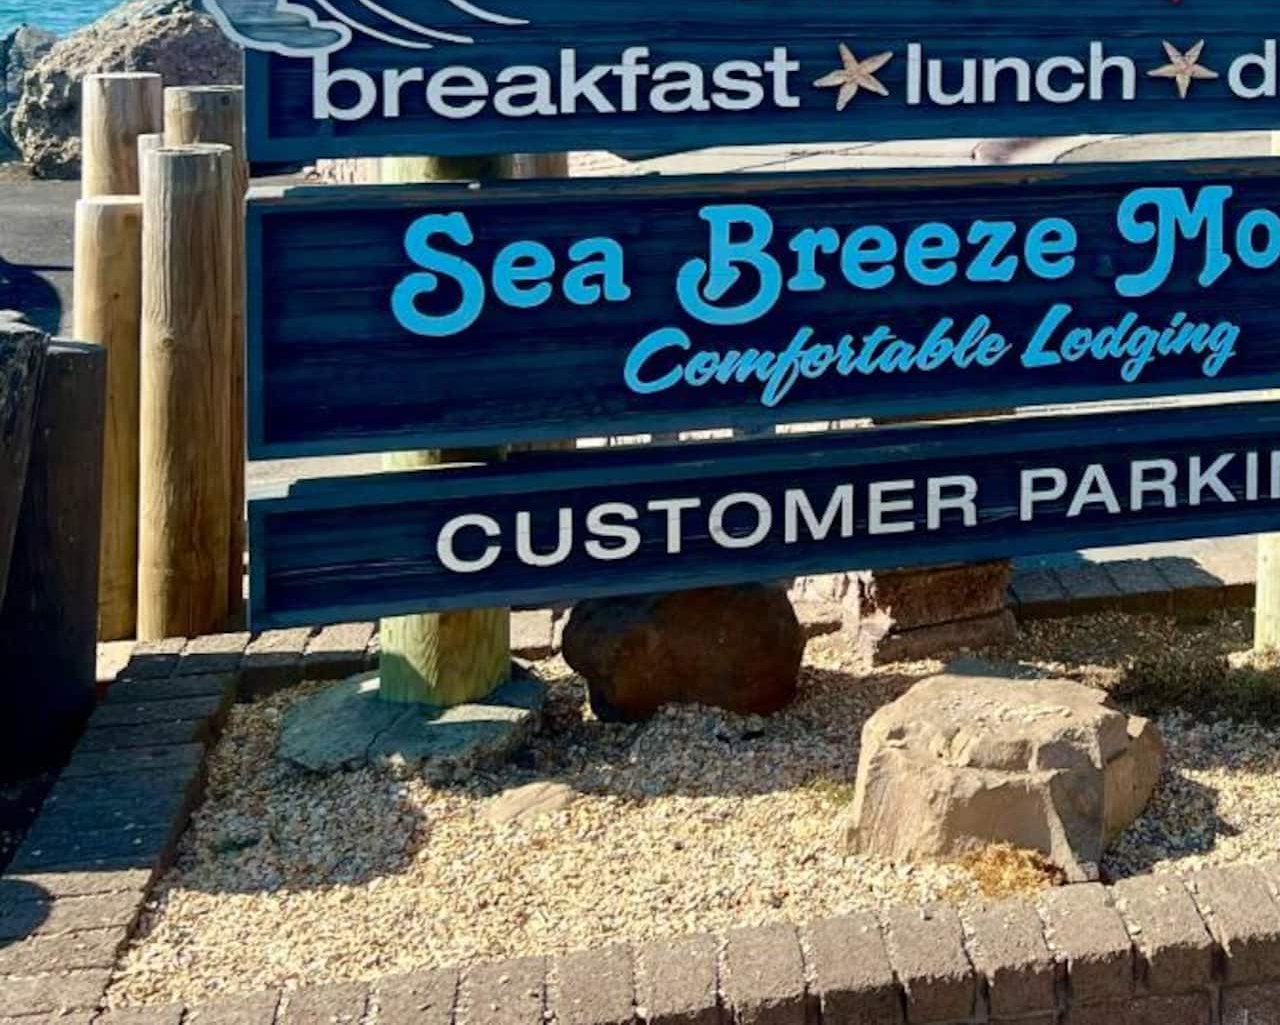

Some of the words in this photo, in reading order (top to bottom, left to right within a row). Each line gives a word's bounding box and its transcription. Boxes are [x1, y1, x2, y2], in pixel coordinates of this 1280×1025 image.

[313, 46, 801, 120] breakfast
[906, 40, 1136, 105] lunch
[391, 211, 631, 336] Sea
[676, 204, 1077, 325] Breeze
[624, 314, 1012, 407] Comfortable
[1020, 304, 1240, 382] Lodging
[436, 474, 978, 573] CUSTOMER
